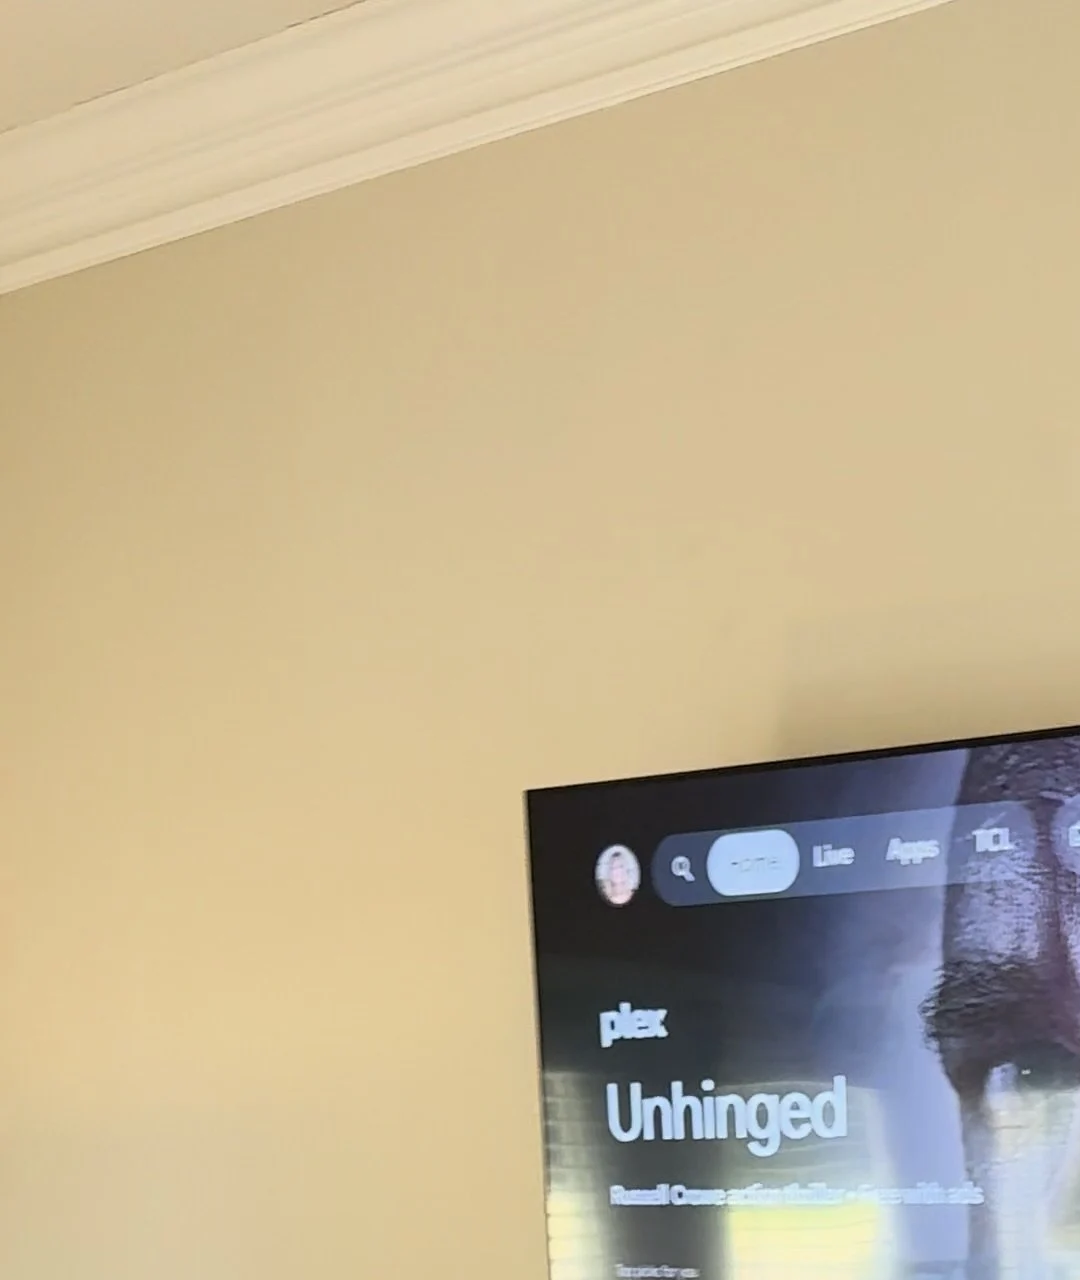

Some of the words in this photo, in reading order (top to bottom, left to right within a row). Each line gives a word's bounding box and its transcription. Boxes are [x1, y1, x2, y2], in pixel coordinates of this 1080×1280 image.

[812, 844, 855, 868] Live
[885, 837, 941, 866] Apps
[600, 1002, 669, 1049] plex
[606, 1074, 848, 1158] Unhinged
